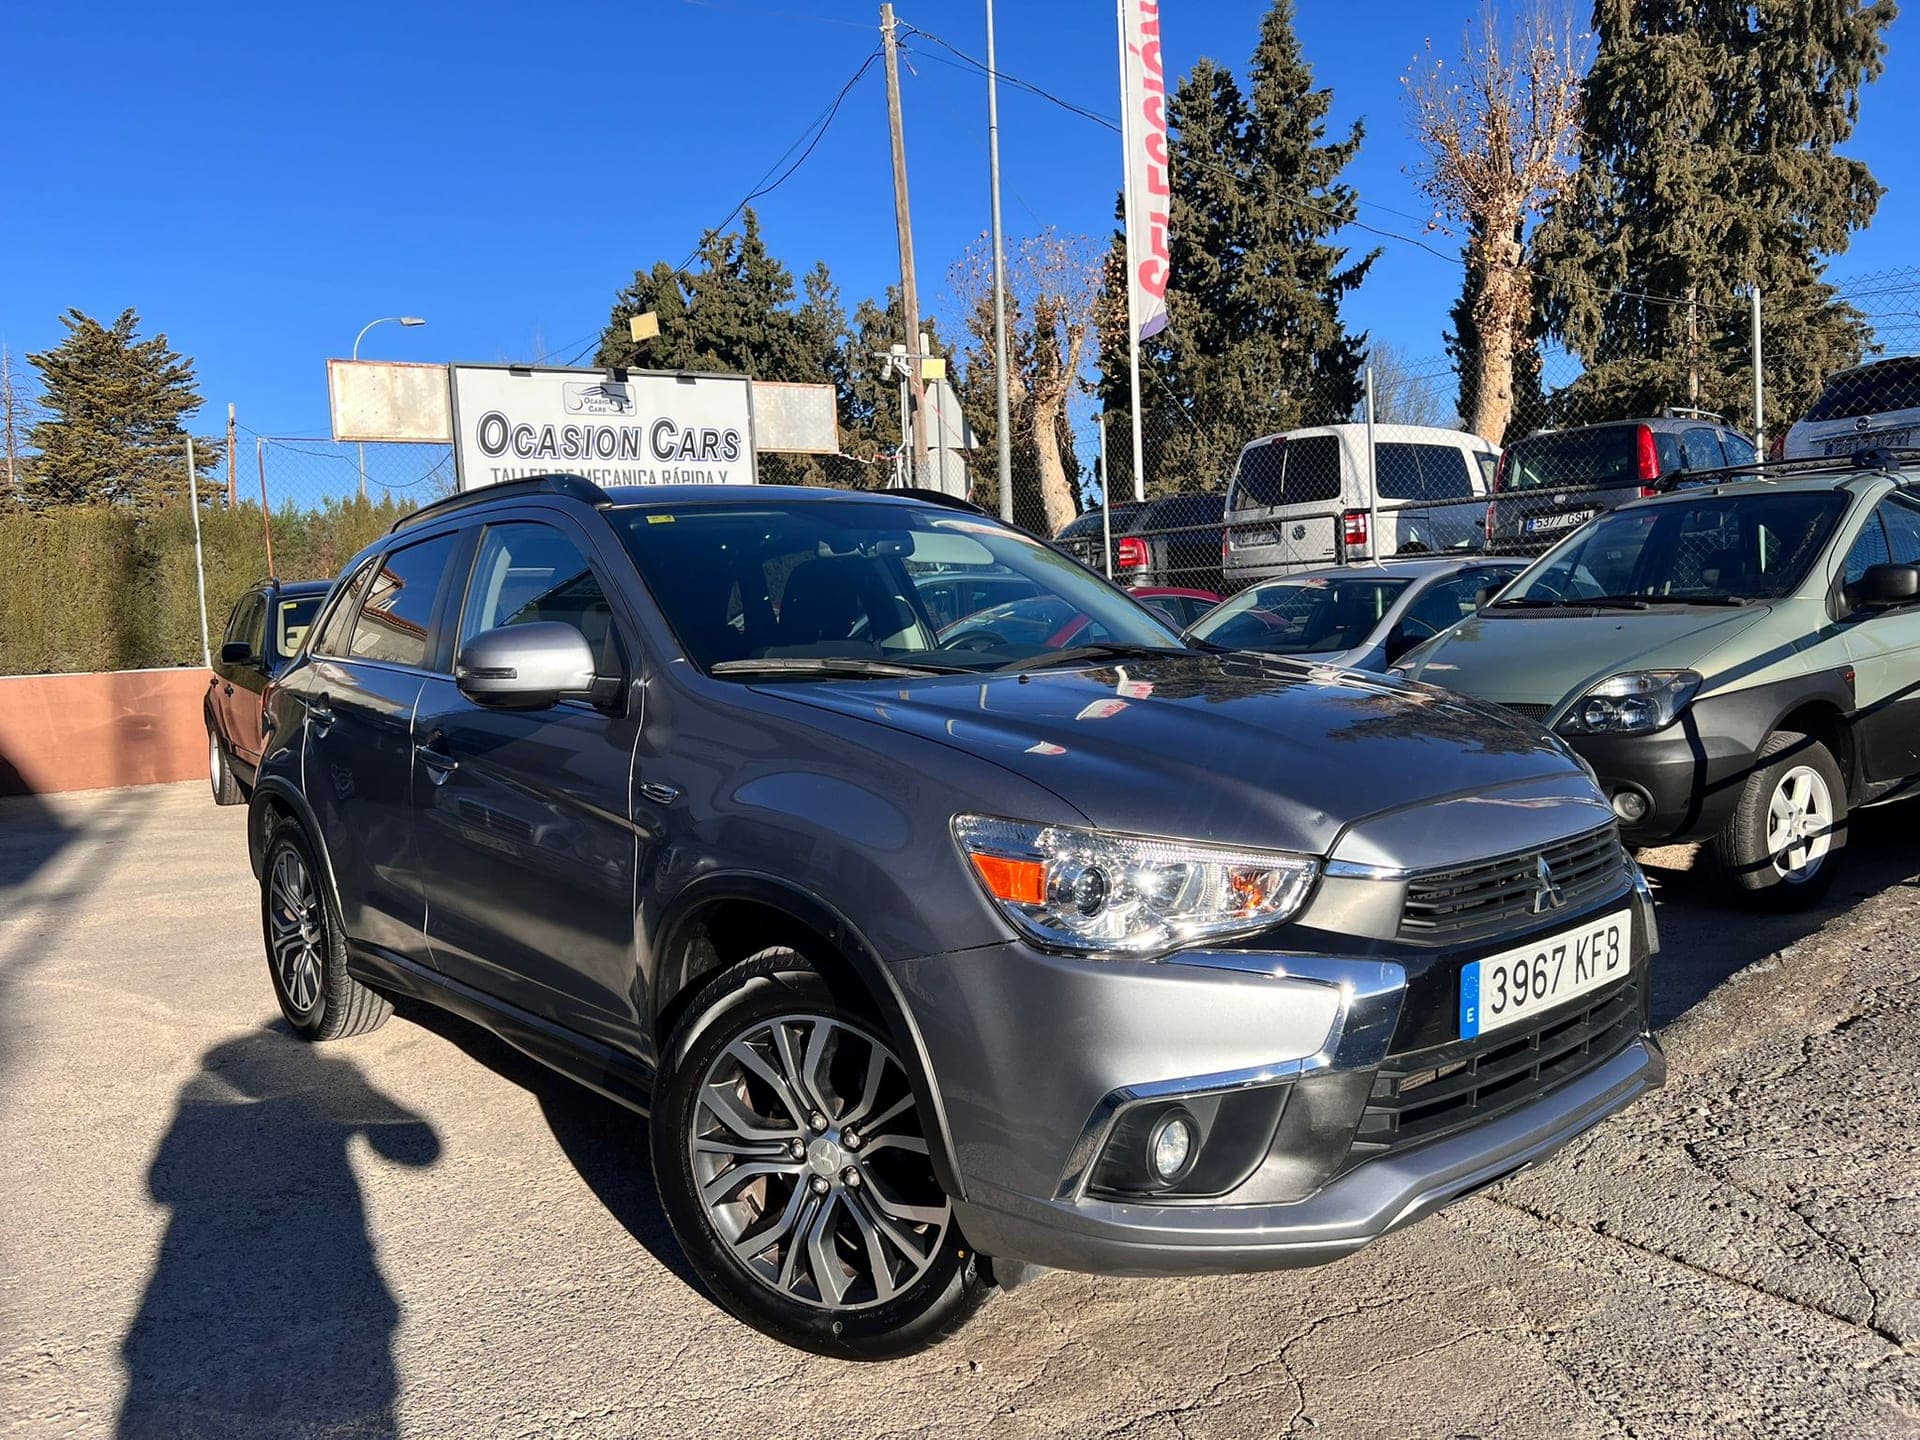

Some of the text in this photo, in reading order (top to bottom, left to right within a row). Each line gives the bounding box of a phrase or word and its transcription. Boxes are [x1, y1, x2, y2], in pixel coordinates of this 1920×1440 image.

[476, 410, 742, 462] OCASION CARS
[661, 466, 715, 485] RÁPIDA
[717, 470, 728, 484] Y
[1535, 514, 1563, 528] 5377
[1466, 925, 1621, 1024] E 3967 KFB
